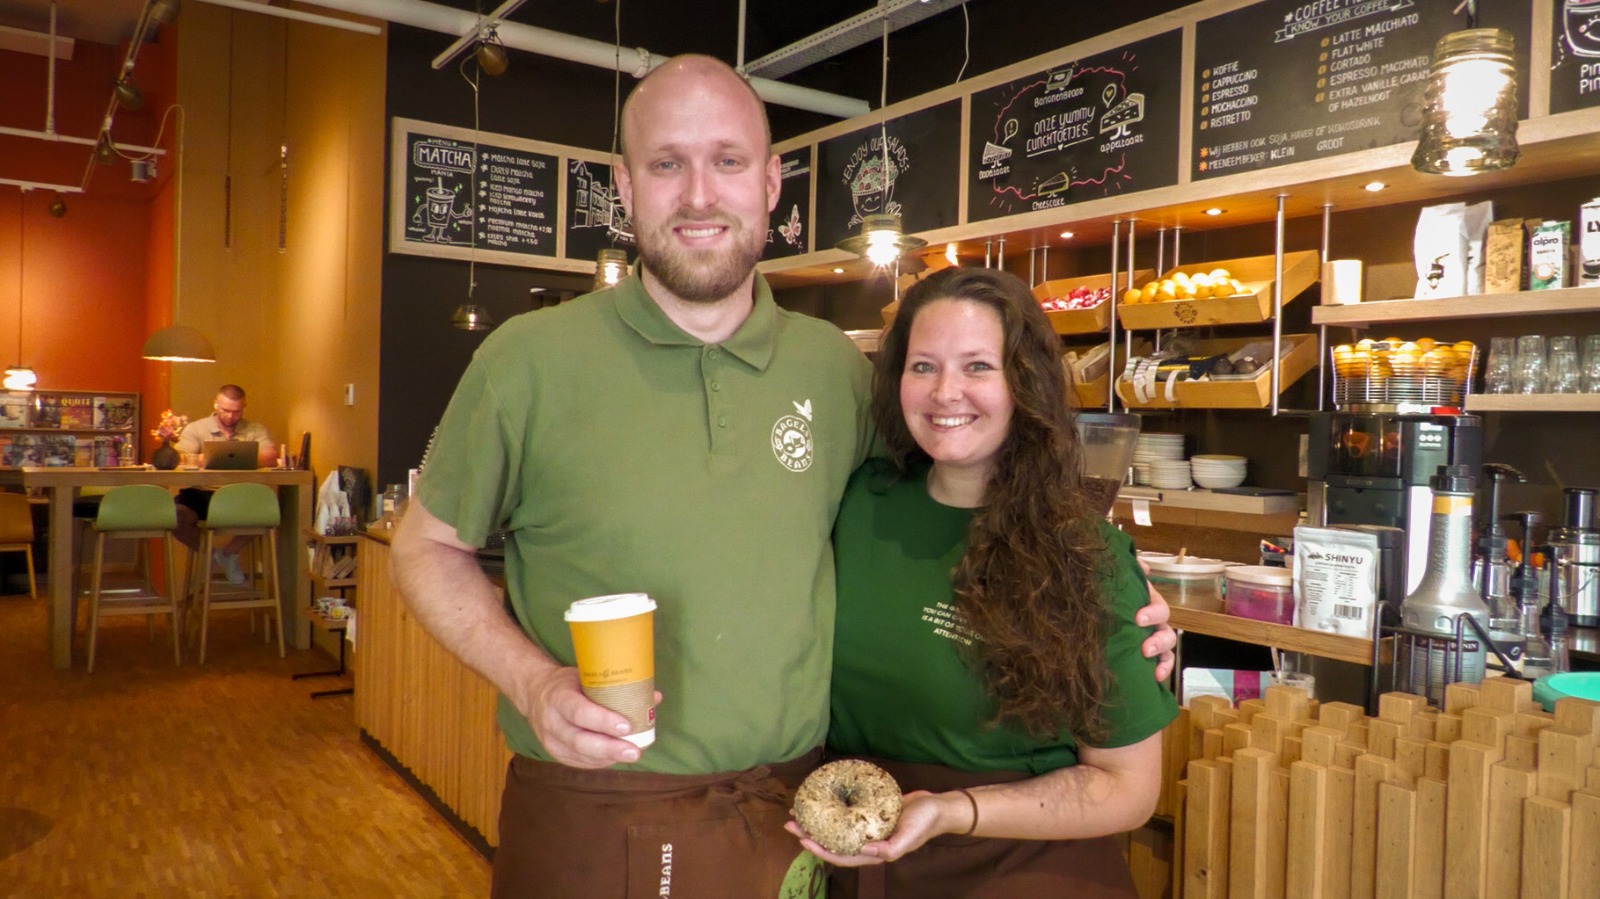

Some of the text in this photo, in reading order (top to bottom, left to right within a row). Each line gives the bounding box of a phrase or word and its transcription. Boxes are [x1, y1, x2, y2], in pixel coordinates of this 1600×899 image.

[1291, 0, 1389, 33] KNOW YOUR COFFEE
[1332, 13, 1419, 45] LATTE MACCHIATO
[1332, 37, 1385, 59] FLAT WHITE
[1213, 61, 1239, 76] KOFFIE
[1330, 54, 1371, 72] CORTADO
[1330, 56, 1429, 86] ESPRESSO MACCHIATO
[1212, 69, 1258, 89] CAPPUCCINO
[1329, 86, 1358, 100] EXTRA
[1400, 70, 1431, 84] CARAM
[1212, 84, 1249, 102] ESPRESSO
[1328, 90, 1392, 113] OF HAZELNOOT
[1211, 95, 1258, 114] MOCHACCINO
[1210, 110, 1251, 128] RISTRETTO
[1209, 146, 1221, 158] WIJ
[1222, 140, 1249, 154] HEBBEN
[1250, 137, 1266, 148] OOK
[1315, 125, 1327, 137] OF
[1327, 117, 1381, 134] KOKOSDRINK
[420, 147, 472, 168] MATCHA
[1270, 146, 1295, 161] KLEIN
[1316, 137, 1344, 151] GROOT
[843, 141, 868, 180] ENJOY
[431, 169, 453, 177] MANIA
[1533, 237, 1559, 247] alpro
[1324, 553, 1364, 565] SHINYU
[923, 607, 952, 618] YOU CAN
[659, 843, 673, 896] BEANS
